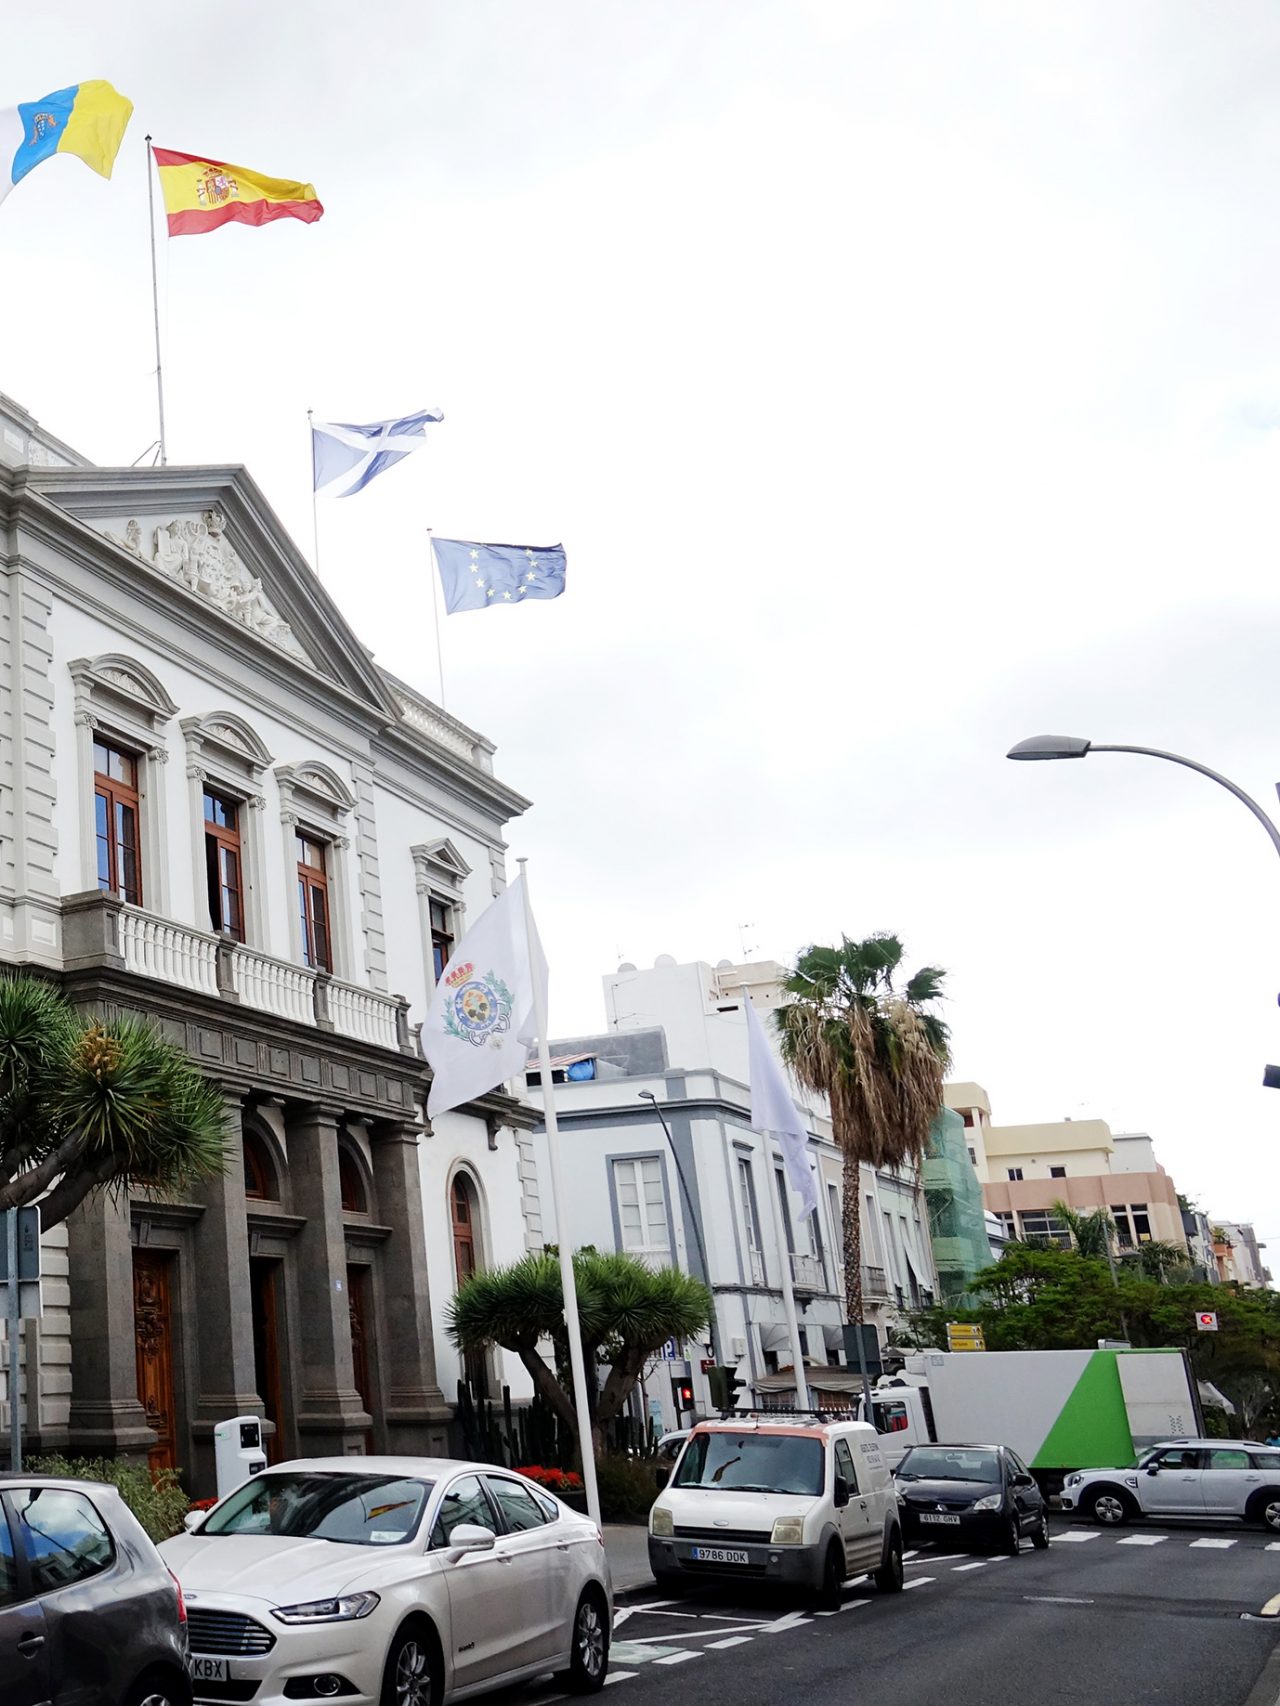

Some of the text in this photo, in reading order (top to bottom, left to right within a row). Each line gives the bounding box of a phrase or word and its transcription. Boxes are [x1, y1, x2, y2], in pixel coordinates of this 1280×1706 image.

[699, 1549, 746, 1562] 9786 DDK
[194, 1659, 222, 1678] KBX
